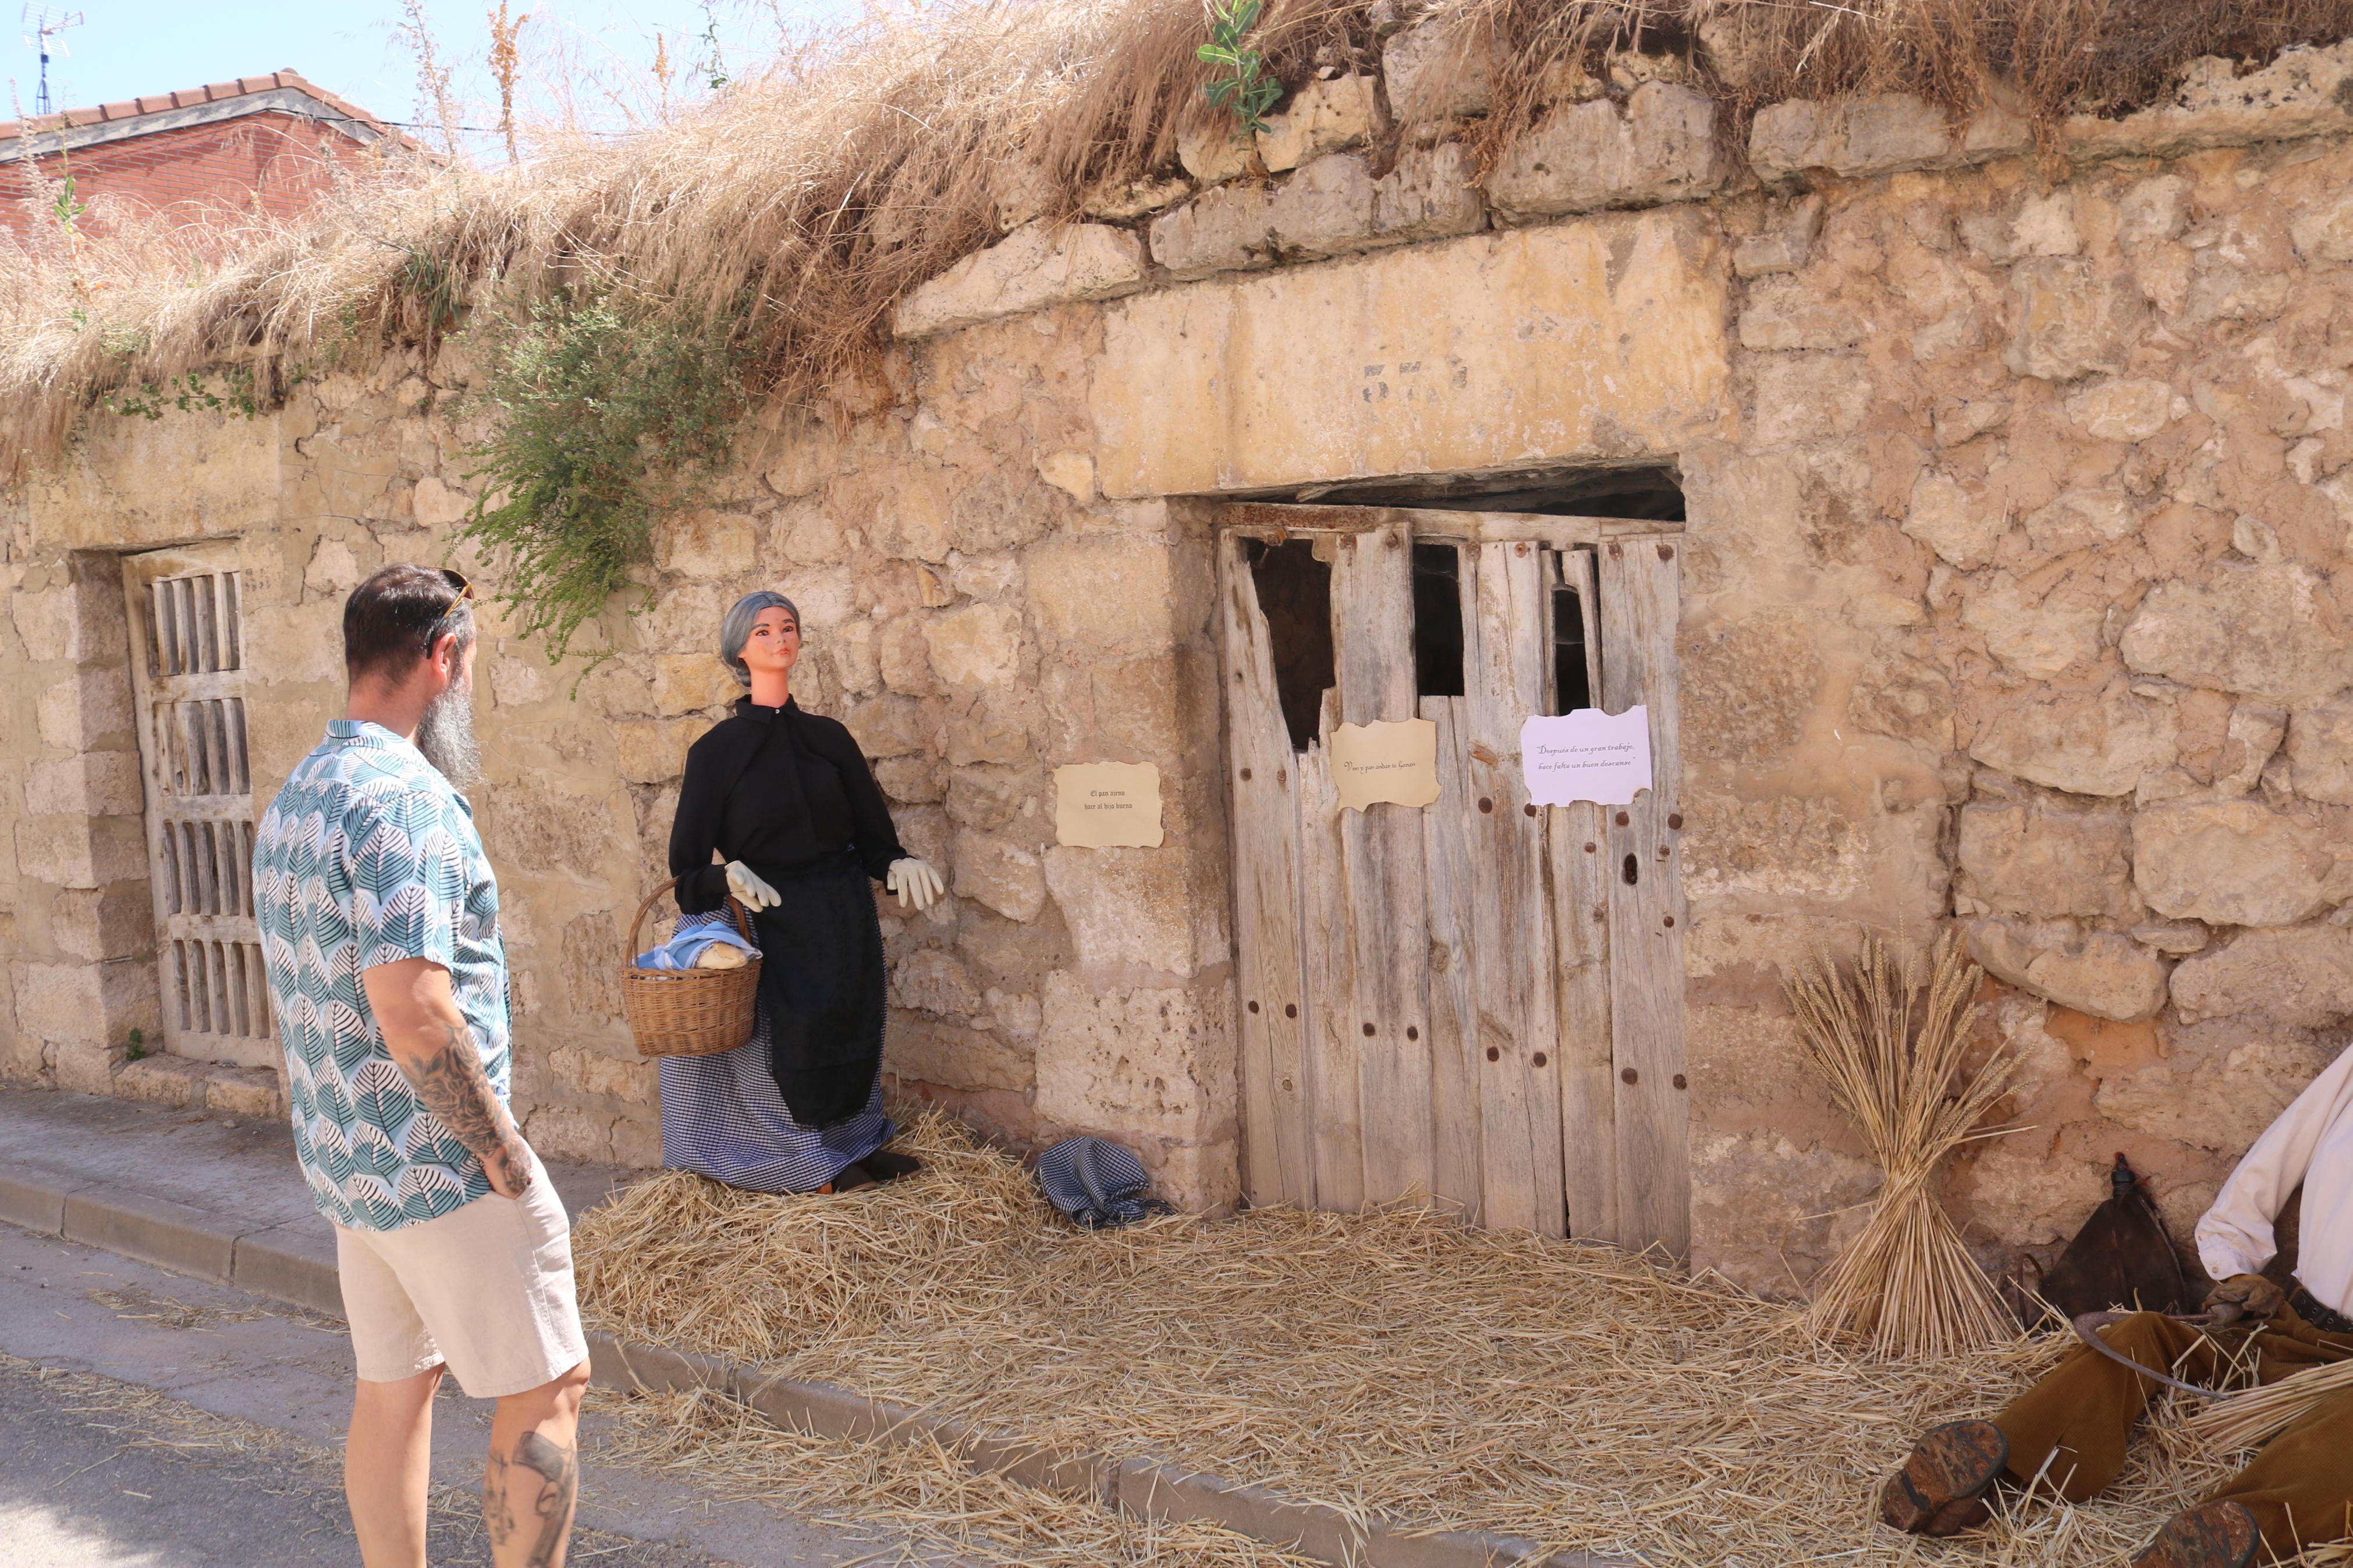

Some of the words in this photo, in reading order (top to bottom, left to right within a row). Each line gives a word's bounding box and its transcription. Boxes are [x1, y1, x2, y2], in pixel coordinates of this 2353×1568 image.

[1589, 746, 1606, 755] gran
[1360, 766, 1364, 774] y
[1375, 761, 1391, 769] andar
[1552, 761, 1570, 773] falta
